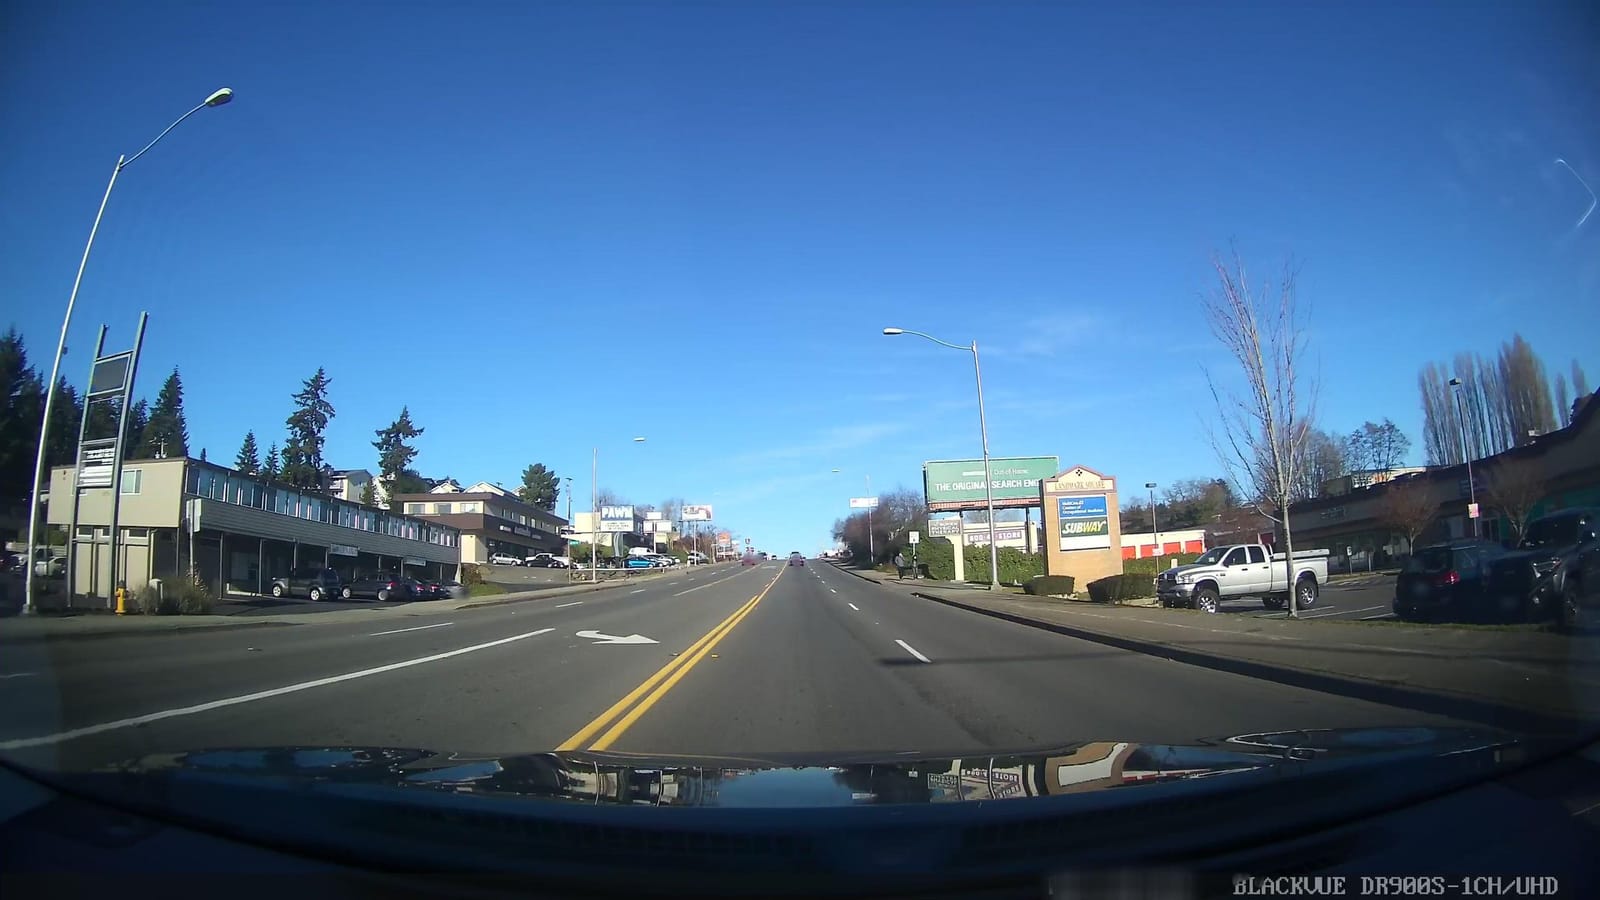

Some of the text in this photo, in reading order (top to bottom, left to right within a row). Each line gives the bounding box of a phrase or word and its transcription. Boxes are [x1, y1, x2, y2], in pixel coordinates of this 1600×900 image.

[936, 482, 952, 492] THE
[952, 480, 989, 491] ORIGINA
[991, 479, 1022, 489] SEARCH
[602, 506, 633, 518] PAWN
[1062, 520, 1107, 534] SUBWAY
